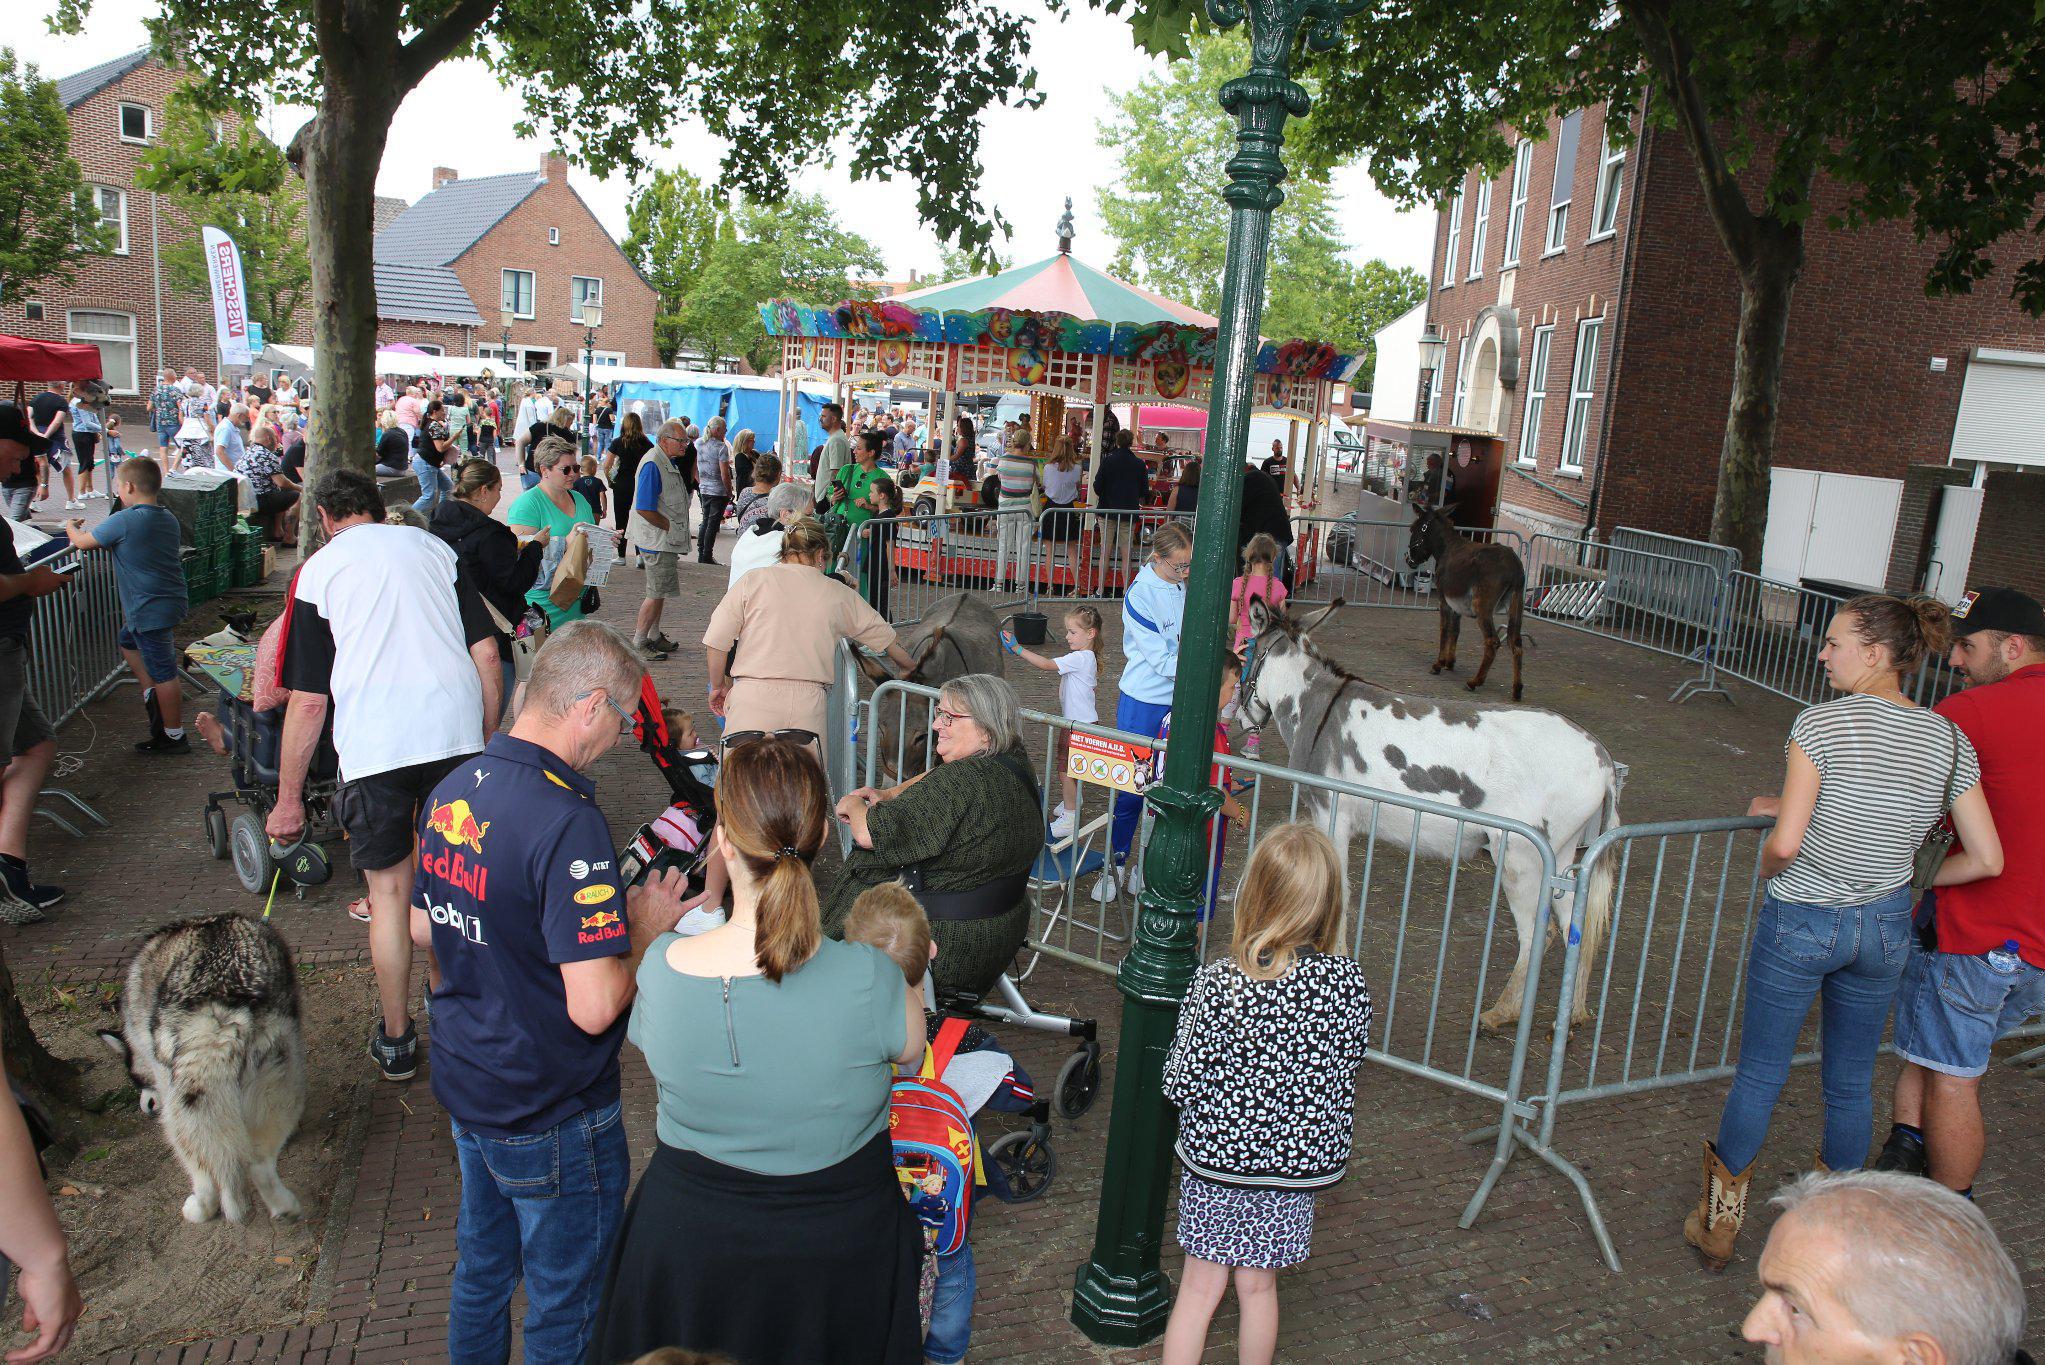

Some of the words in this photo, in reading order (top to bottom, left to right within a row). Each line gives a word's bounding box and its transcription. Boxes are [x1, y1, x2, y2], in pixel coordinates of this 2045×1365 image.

[1085, 737, 1108, 748] VOEREN
[421, 839, 449, 881] ed
[592, 861, 610, 872] AT&T
[586, 888, 609, 899] RAUCH
[577, 928, 604, 944] Red
[604, 923, 626, 939] Bull
[1178, 1015, 1194, 1048] FASHION
[1169, 1047, 1184, 1077] ADDICT
